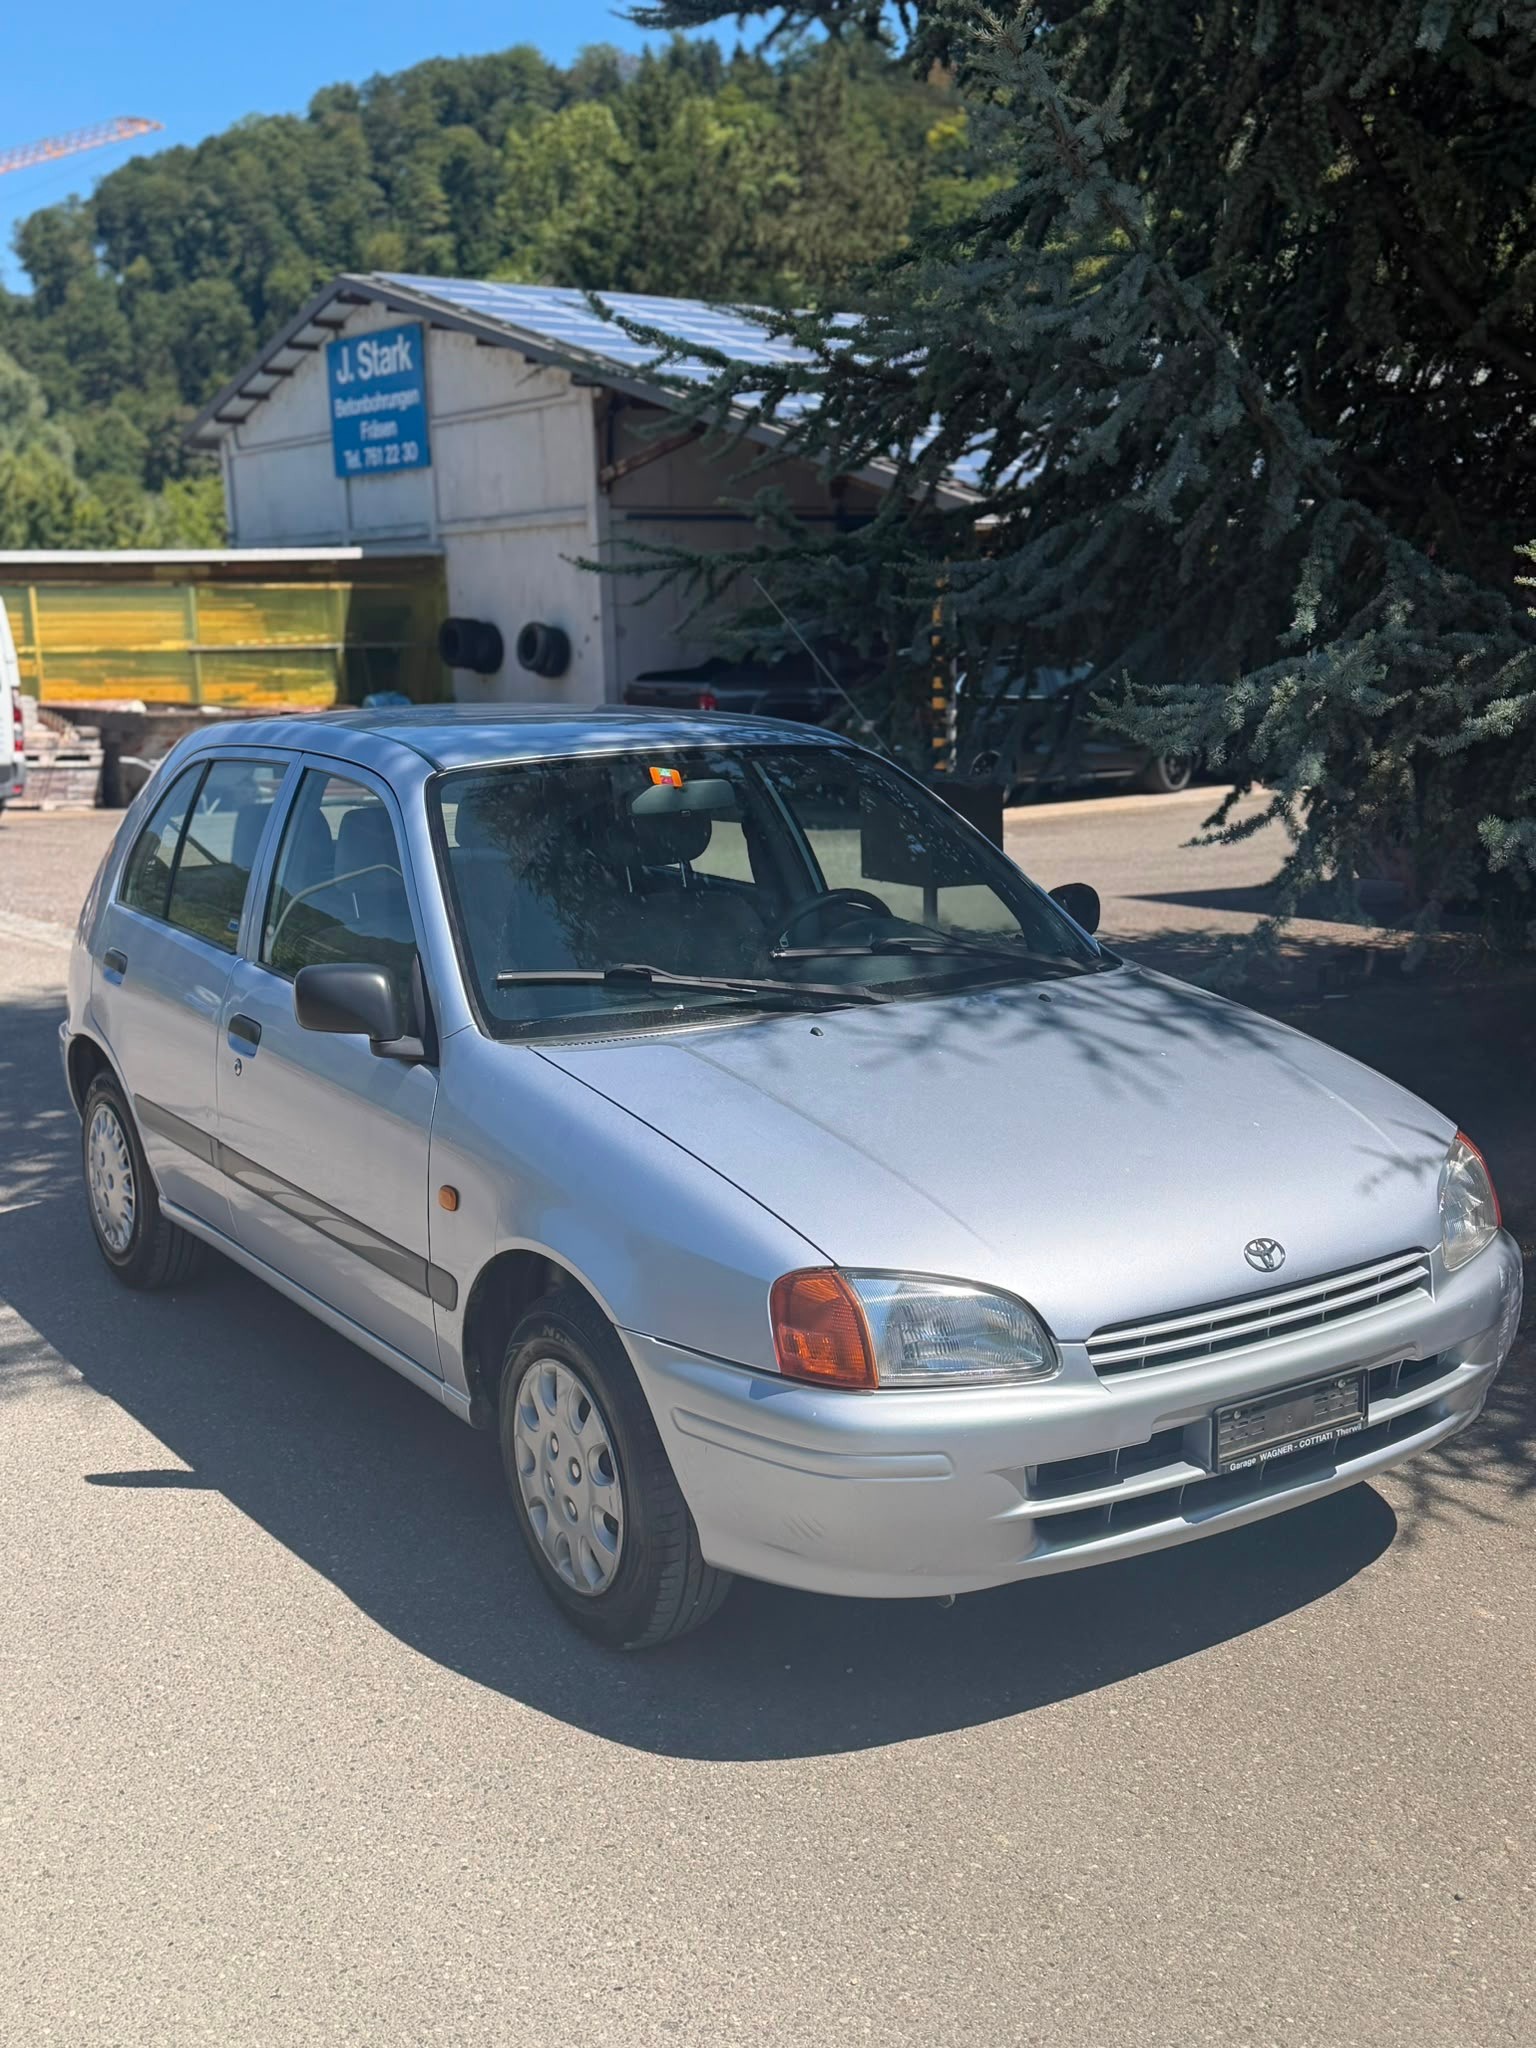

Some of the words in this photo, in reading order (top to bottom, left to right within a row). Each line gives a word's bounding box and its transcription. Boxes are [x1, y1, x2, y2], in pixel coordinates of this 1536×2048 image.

[336, 346, 354, 385] J.
[357, 334, 413, 380] Stark
[335, 389, 419, 418] Betonbohrungen
[360, 419, 398, 441] Fräsen
[343, 449, 362, 469] Tel.
[385, 443, 400, 465] 22
[401, 441, 418, 463] 30
[1230, 1457, 1257, 1471] Garage
[1259, 1444, 1293, 1461] WAGNER
[1299, 1431, 1333, 1448] COTTIATI
[1336, 1422, 1362, 1437] Therwil
